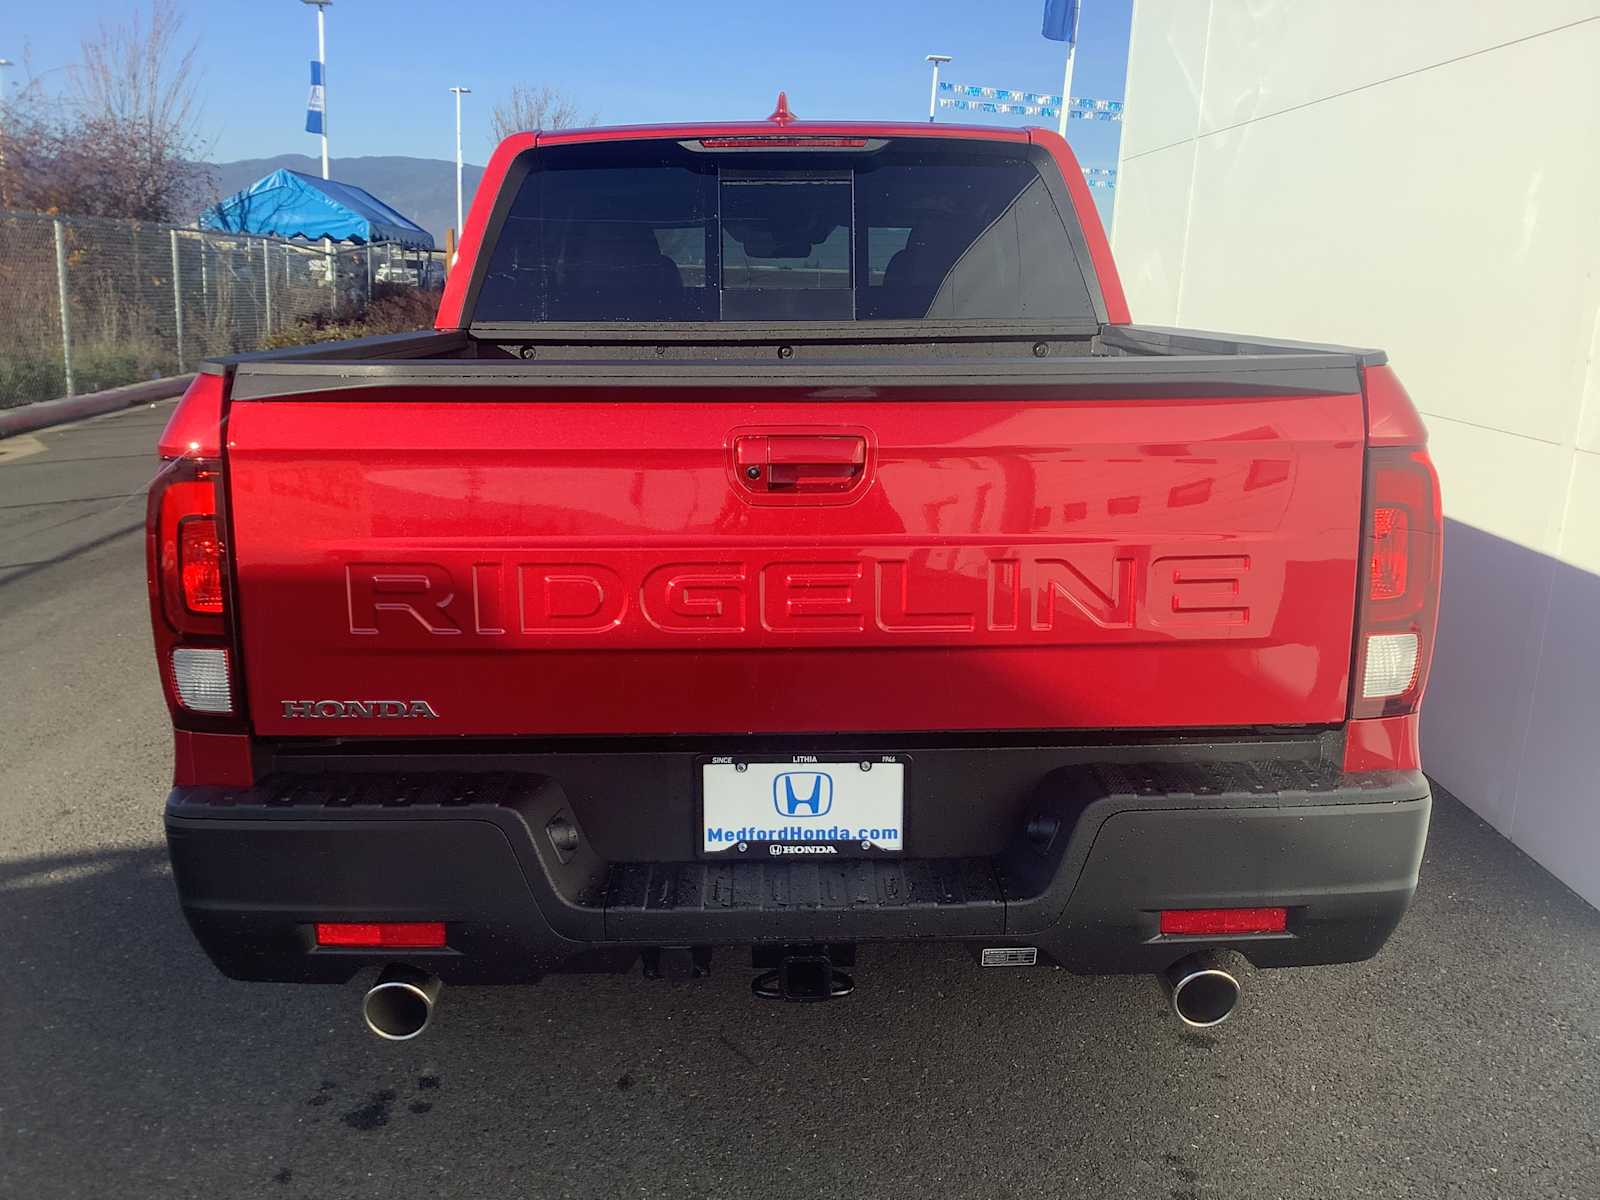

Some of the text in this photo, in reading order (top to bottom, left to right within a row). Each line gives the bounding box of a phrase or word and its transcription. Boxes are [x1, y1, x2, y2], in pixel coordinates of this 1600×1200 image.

[345, 554, 1251, 635] RIDGELINE
[280, 700, 440, 719] HONDA
[711, 756, 733, 764] SINCE
[792, 755, 818, 763] LITHIA
[707, 826, 899, 842] MedfordHonda.com
[782, 845, 838, 855] HONDA
